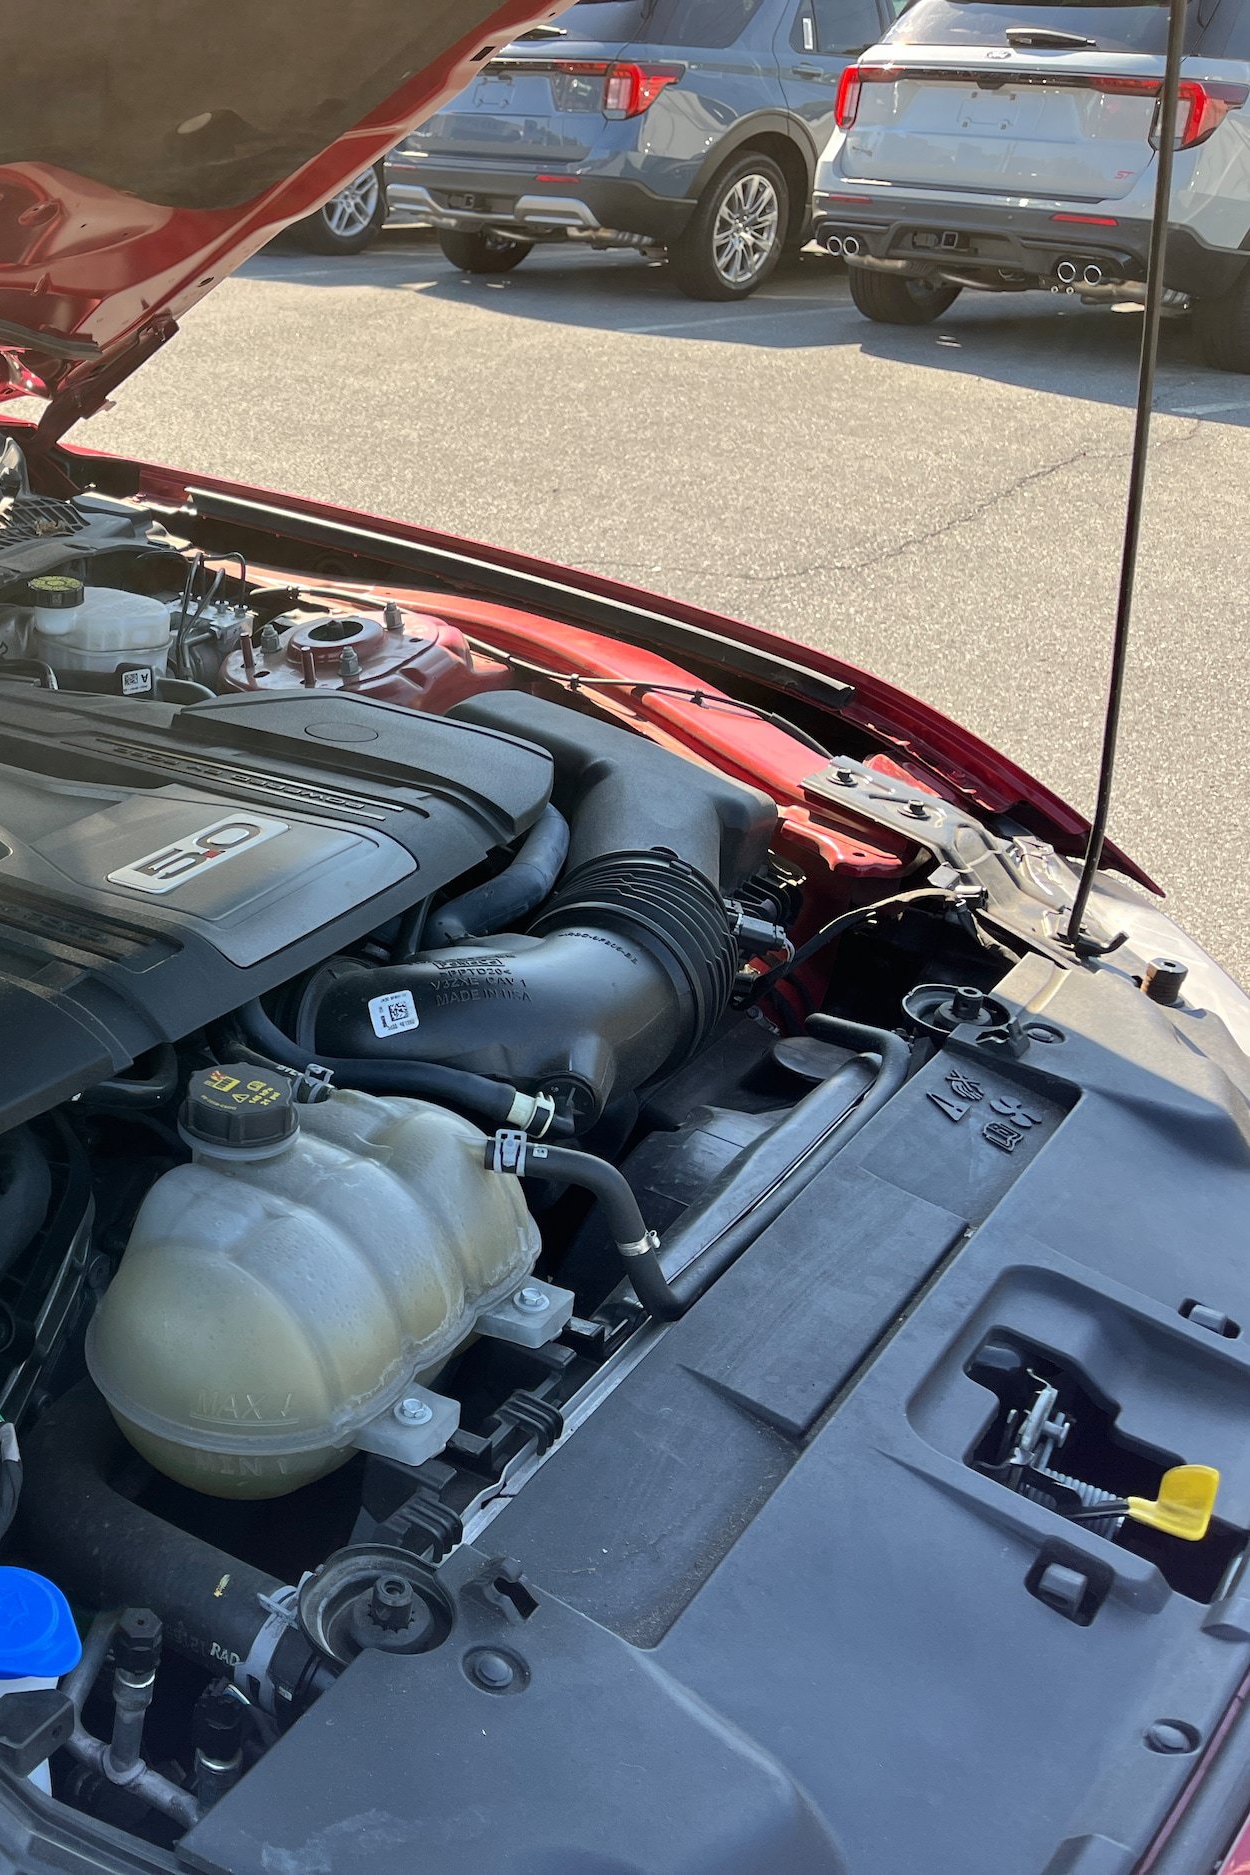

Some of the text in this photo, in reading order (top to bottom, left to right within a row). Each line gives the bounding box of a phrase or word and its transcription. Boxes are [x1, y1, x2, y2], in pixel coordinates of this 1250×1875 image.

[1114, 170, 1135, 180] ST
[231, 774, 365, 810] POWERED
[133, 822, 261, 880] 5.0
[436, 987, 532, 1007] MADE IN USA
[196, 1391, 267, 1421] MAX
[195, 1453, 262, 1477] MIN
[210, 1641, 241, 1667] RAD
